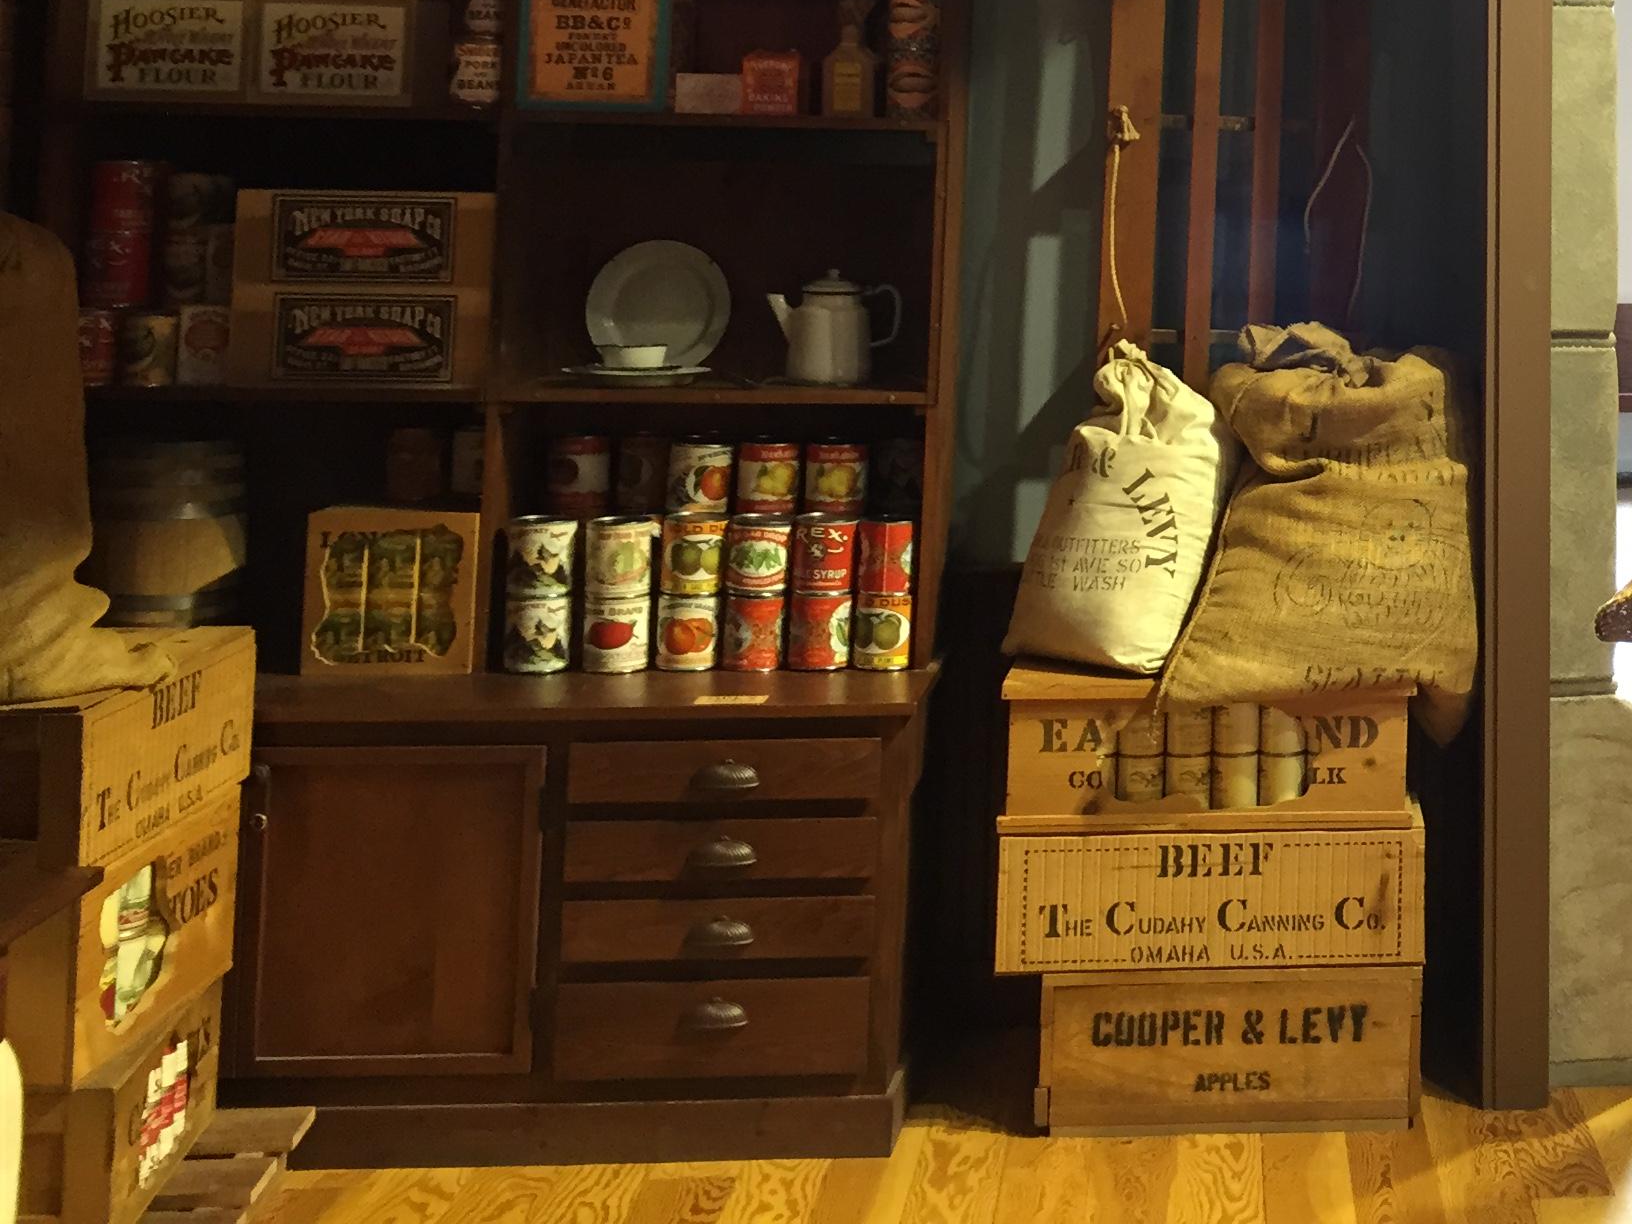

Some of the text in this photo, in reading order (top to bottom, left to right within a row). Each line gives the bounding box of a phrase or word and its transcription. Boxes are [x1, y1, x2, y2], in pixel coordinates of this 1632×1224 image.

[112, 7, 224, 40] HOOSIER
[275, 13, 386, 44] HOOSIER
[139, 67, 216, 85] FLOUR
[303, 73, 379, 90] FLOUR
[602, 67, 614, 81] 6
[1122, 467, 1179, 579] LEVY
[813, 568, 847, 581] SYRUP
[1072, 557, 1110, 574] AVE
[1117, 558, 1142, 574] SO
[1073, 575, 1127, 591] WASH
[151, 669, 203, 730] BEEF
[1156, 842, 1274, 879] BEEF
[1039, 897, 1387, 939] THE CUDAHY CANNING CO.
[1131, 945, 1210, 965] OMAHA
[1092, 1003, 1370, 1048] COOPER & LEVY
[1194, 1071, 1272, 1094] APPLES
